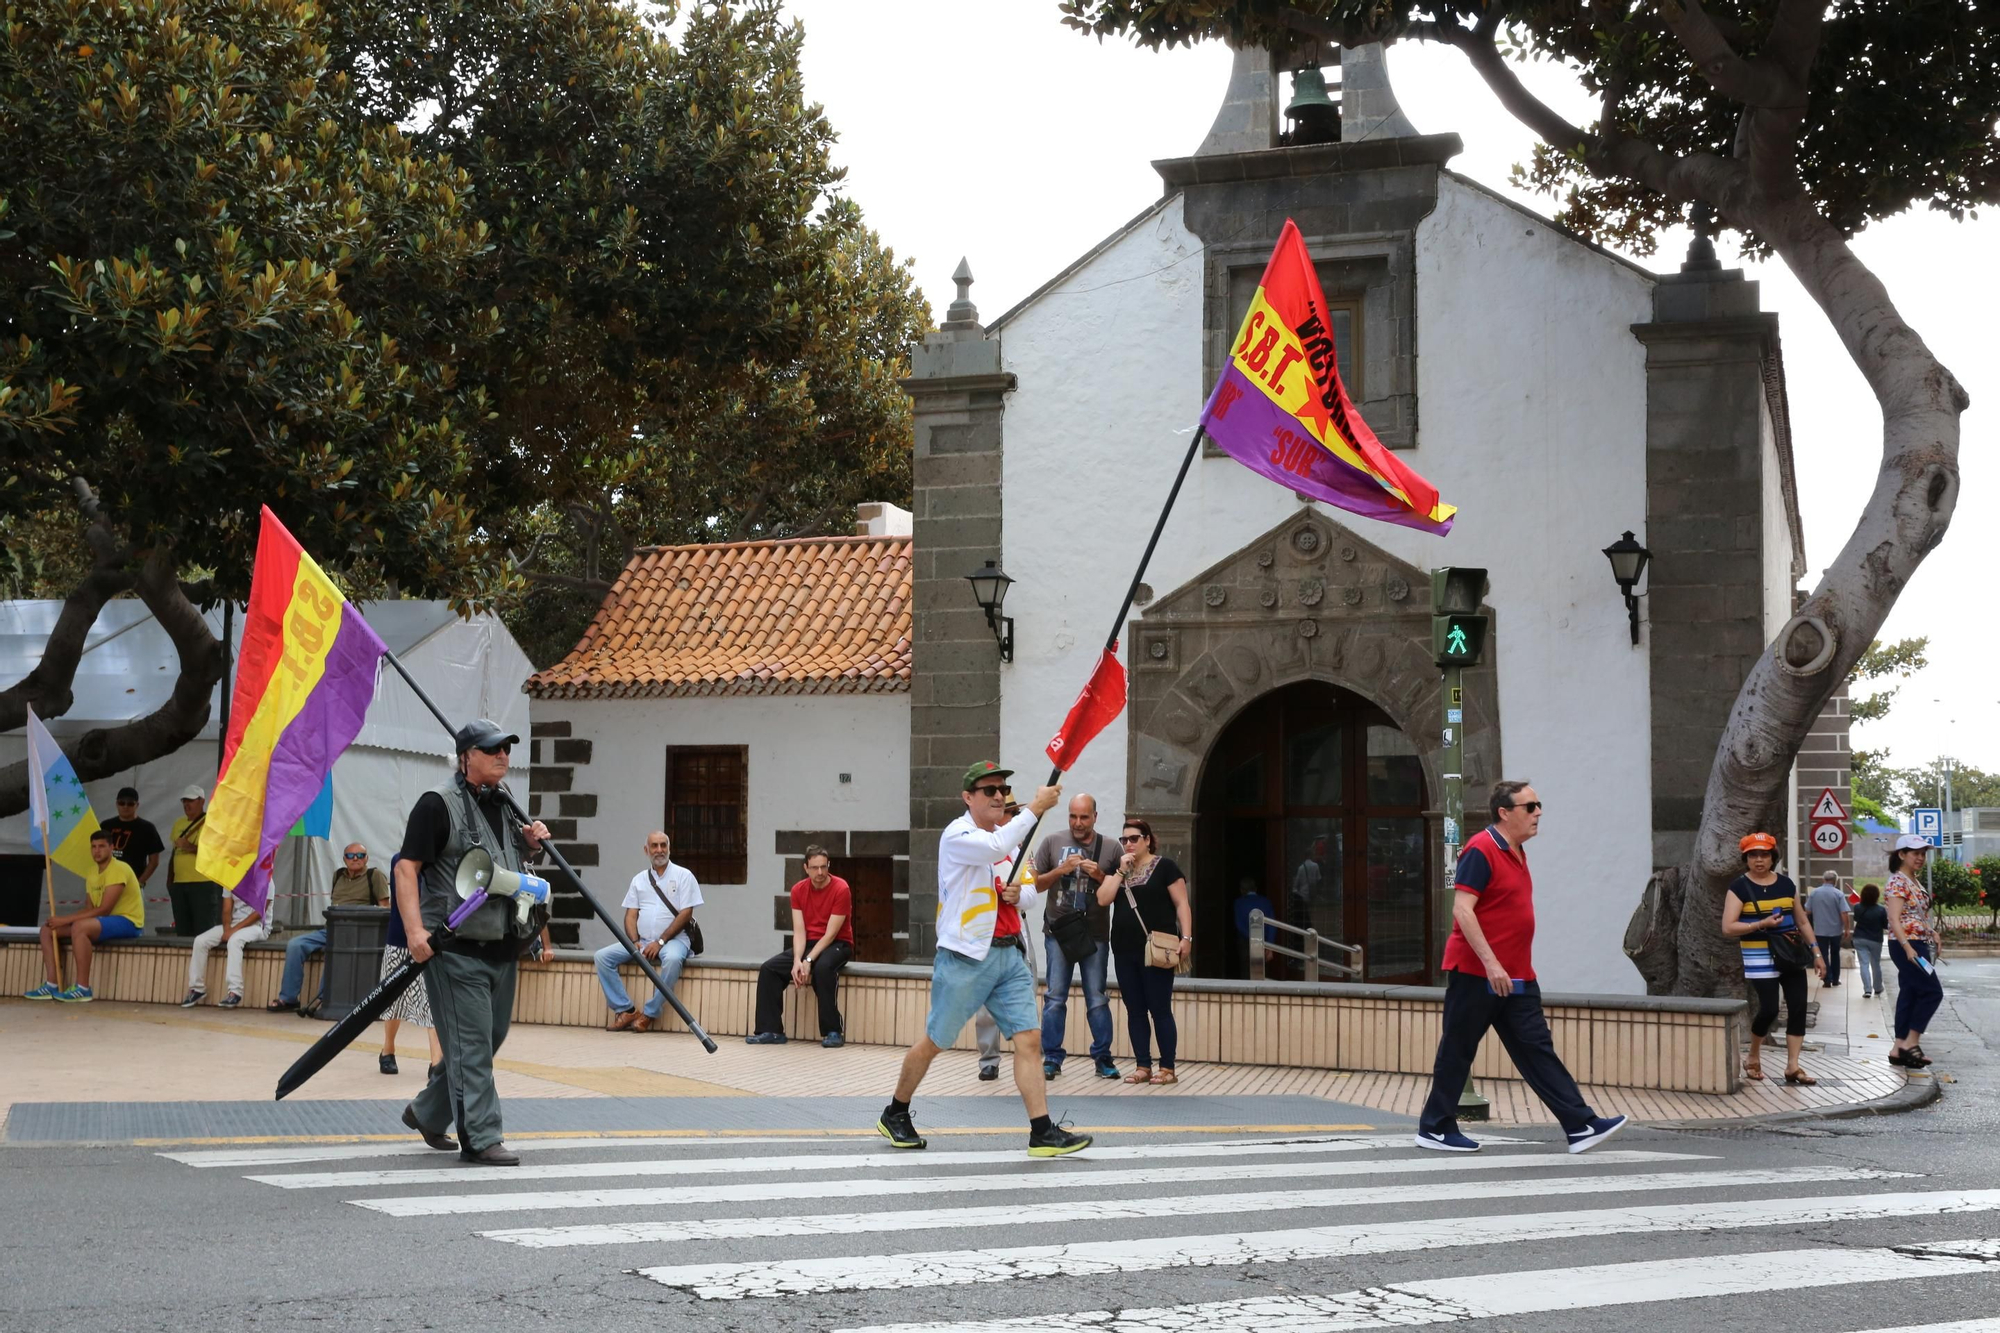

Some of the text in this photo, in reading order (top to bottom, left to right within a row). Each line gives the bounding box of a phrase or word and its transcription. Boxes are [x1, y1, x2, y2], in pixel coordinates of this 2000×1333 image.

[1237, 310, 1304, 396] S.B.T.
[1923, 815, 1934, 828] P
[1817, 832, 1838, 843] 40
